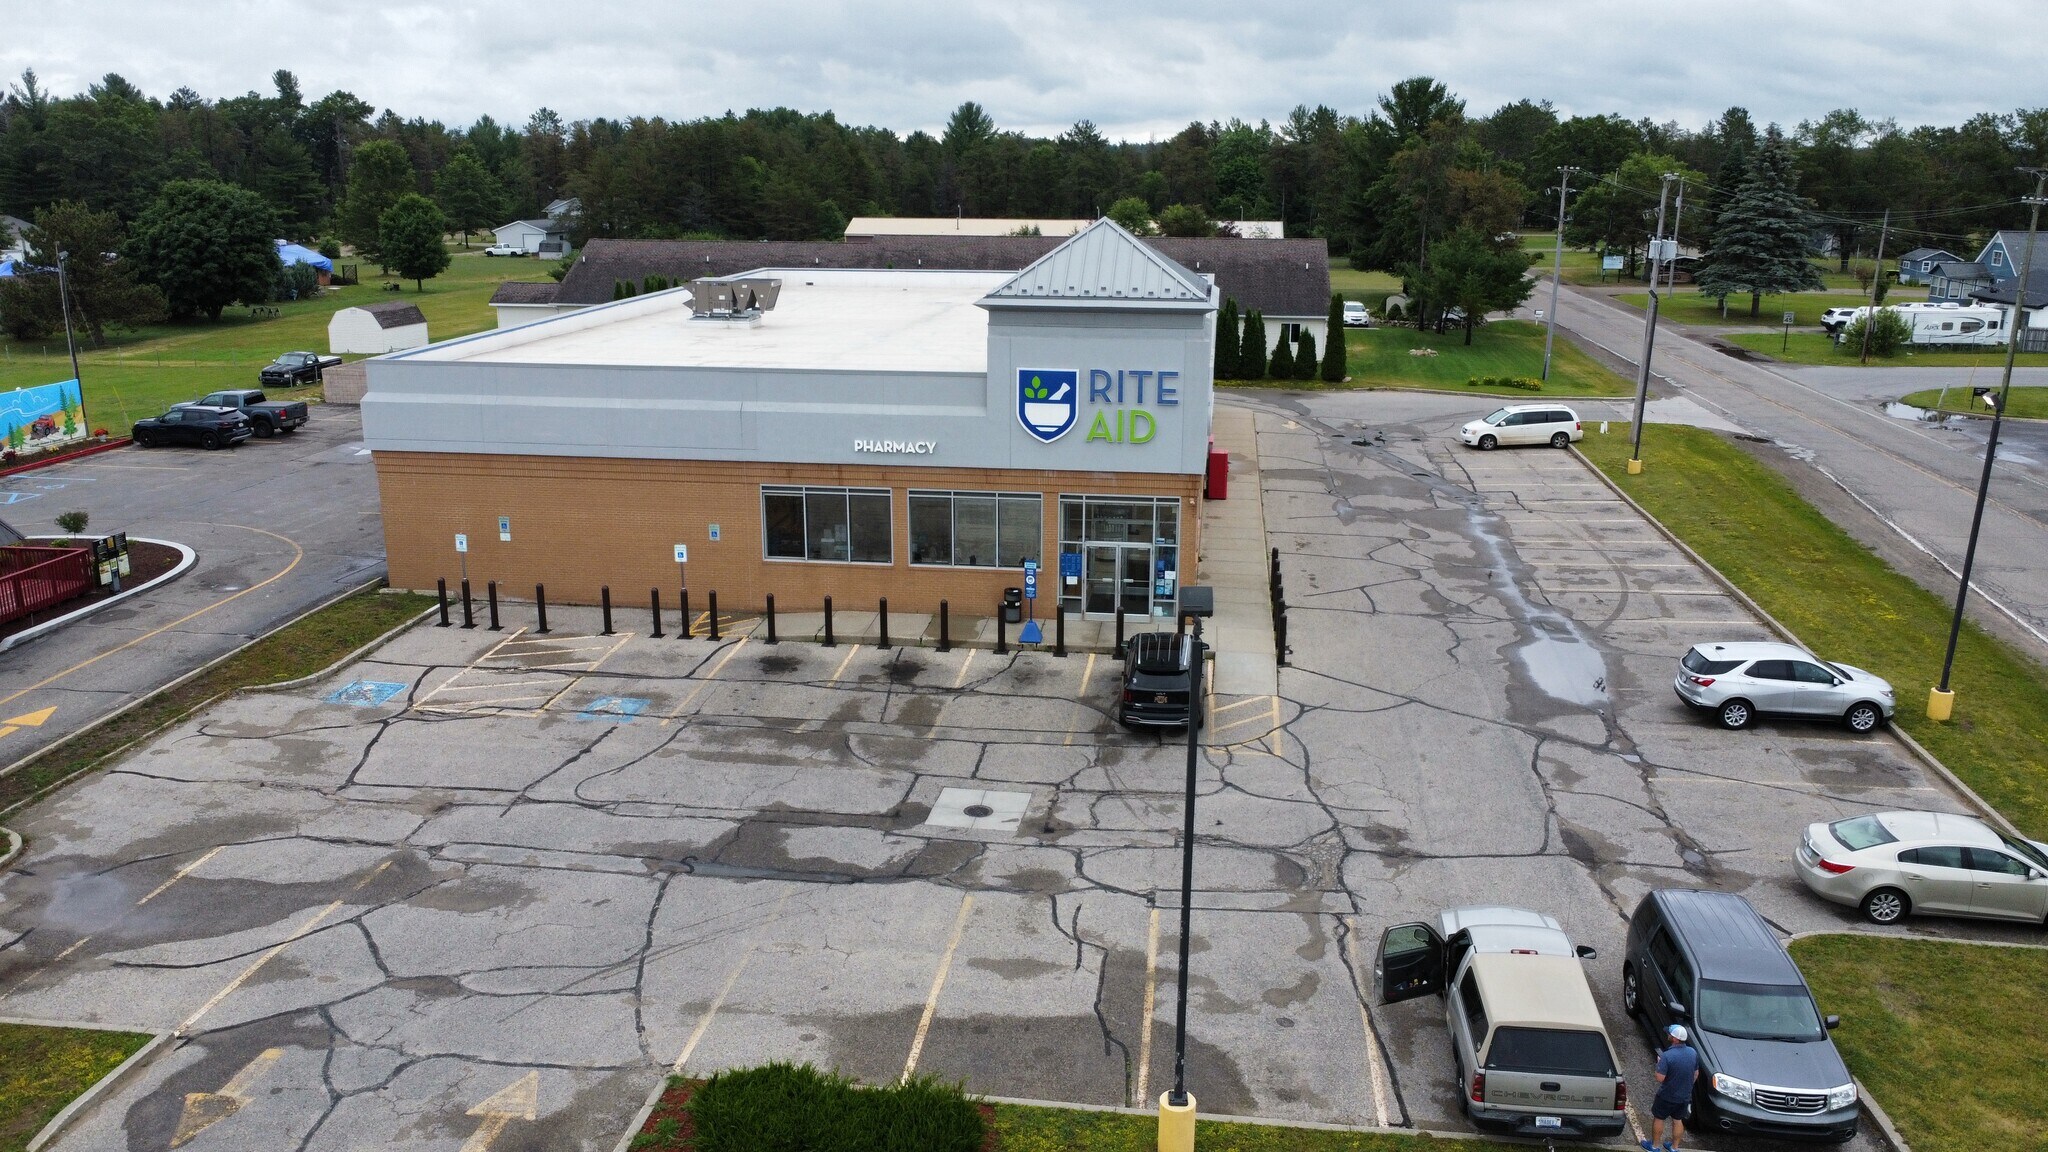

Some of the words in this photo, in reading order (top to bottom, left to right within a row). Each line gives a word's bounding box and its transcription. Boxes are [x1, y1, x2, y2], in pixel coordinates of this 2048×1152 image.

[1089, 369, 1179, 405] RITE
[1087, 409, 1157, 443] AID
[854, 440, 937, 454] PHARMACY
[1491, 1090, 1608, 1103] CHEVROLET
